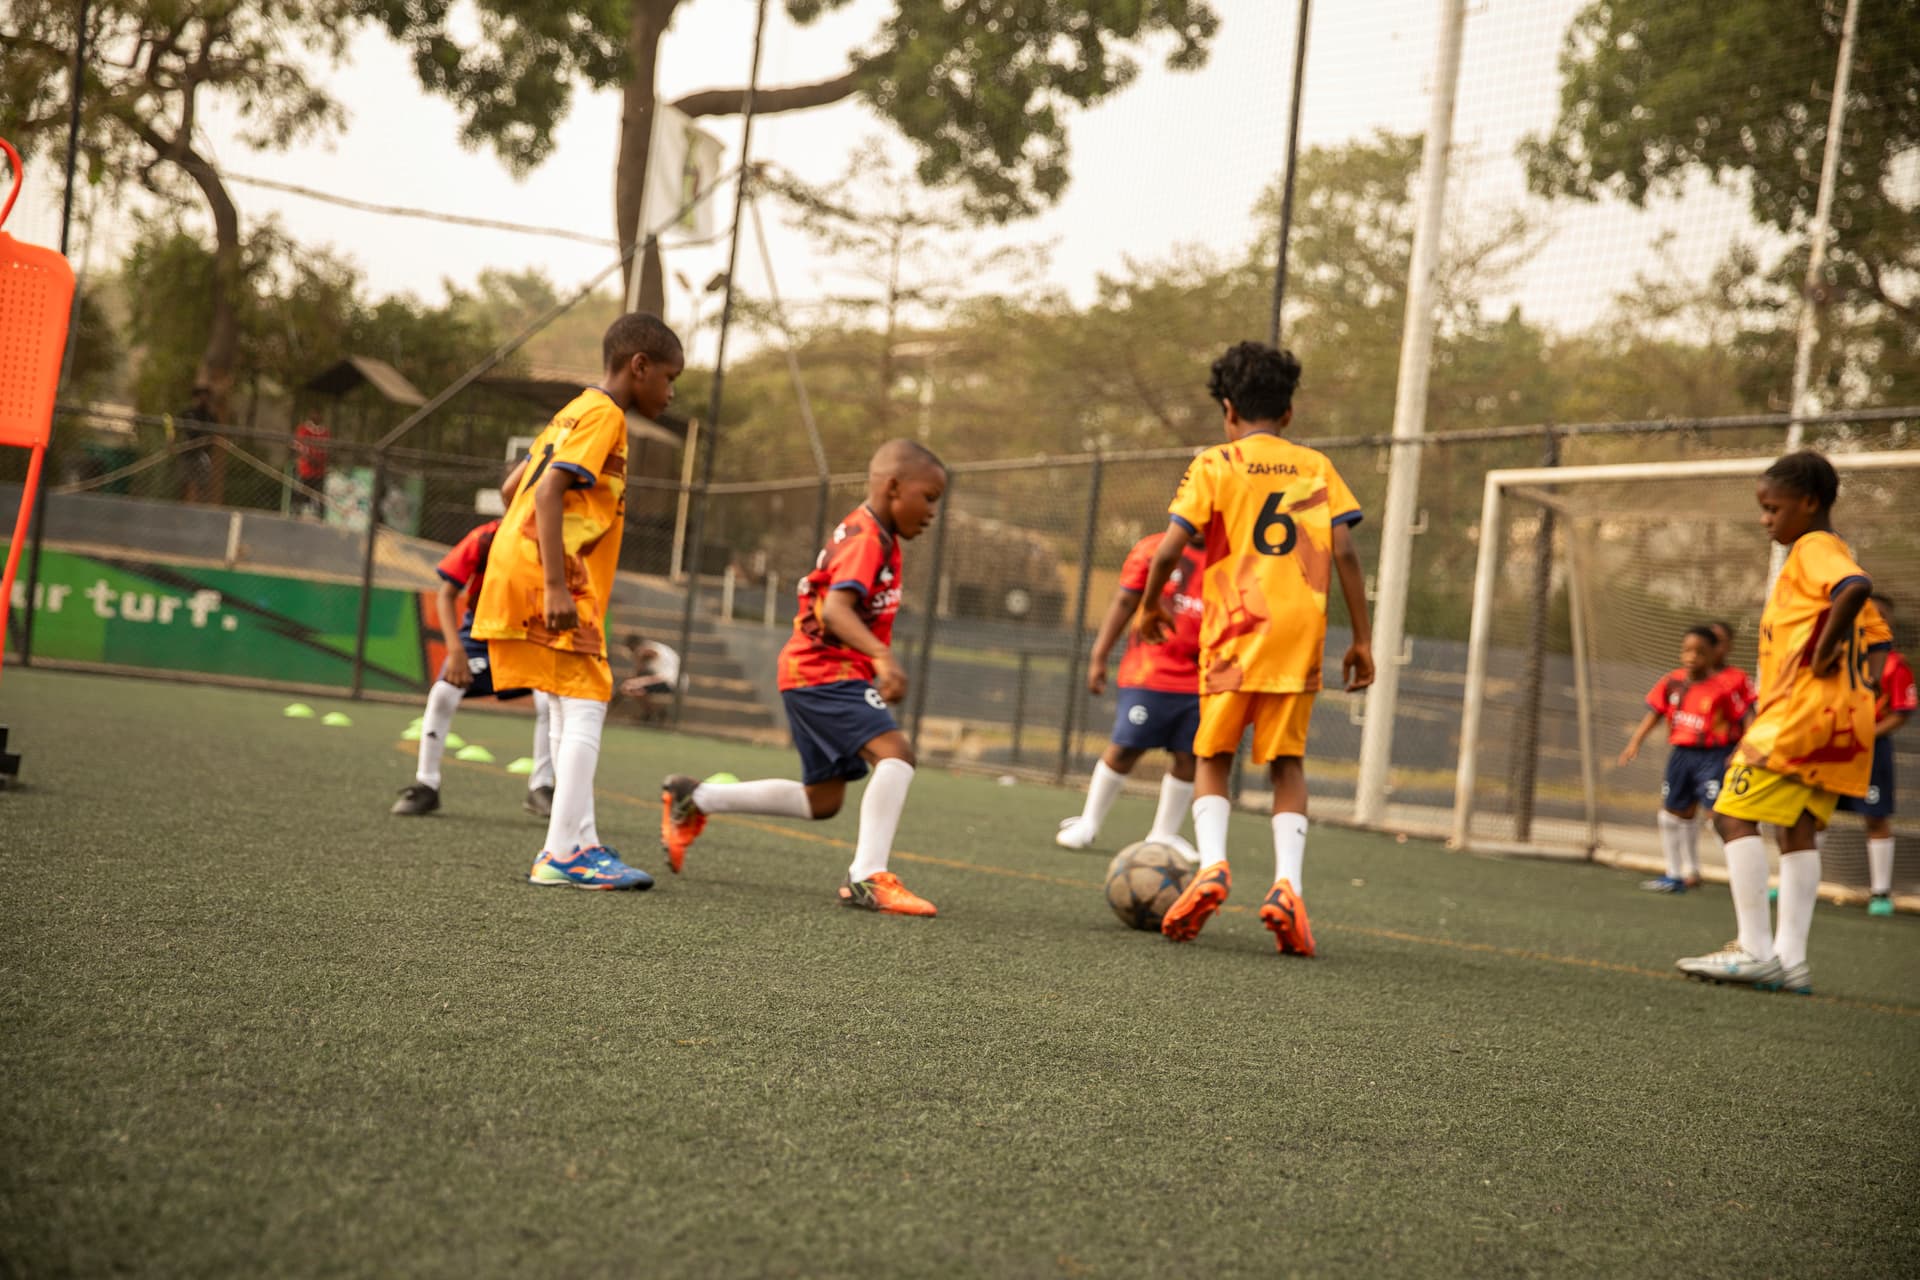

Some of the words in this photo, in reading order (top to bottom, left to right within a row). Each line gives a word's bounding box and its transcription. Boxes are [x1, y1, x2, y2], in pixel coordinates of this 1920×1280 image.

[1247, 462, 1299, 476] ZAHRA
[1252, 491, 1297, 557] 6
[0, 578, 72, 614] ur
[84, 579, 238, 631] turf.
